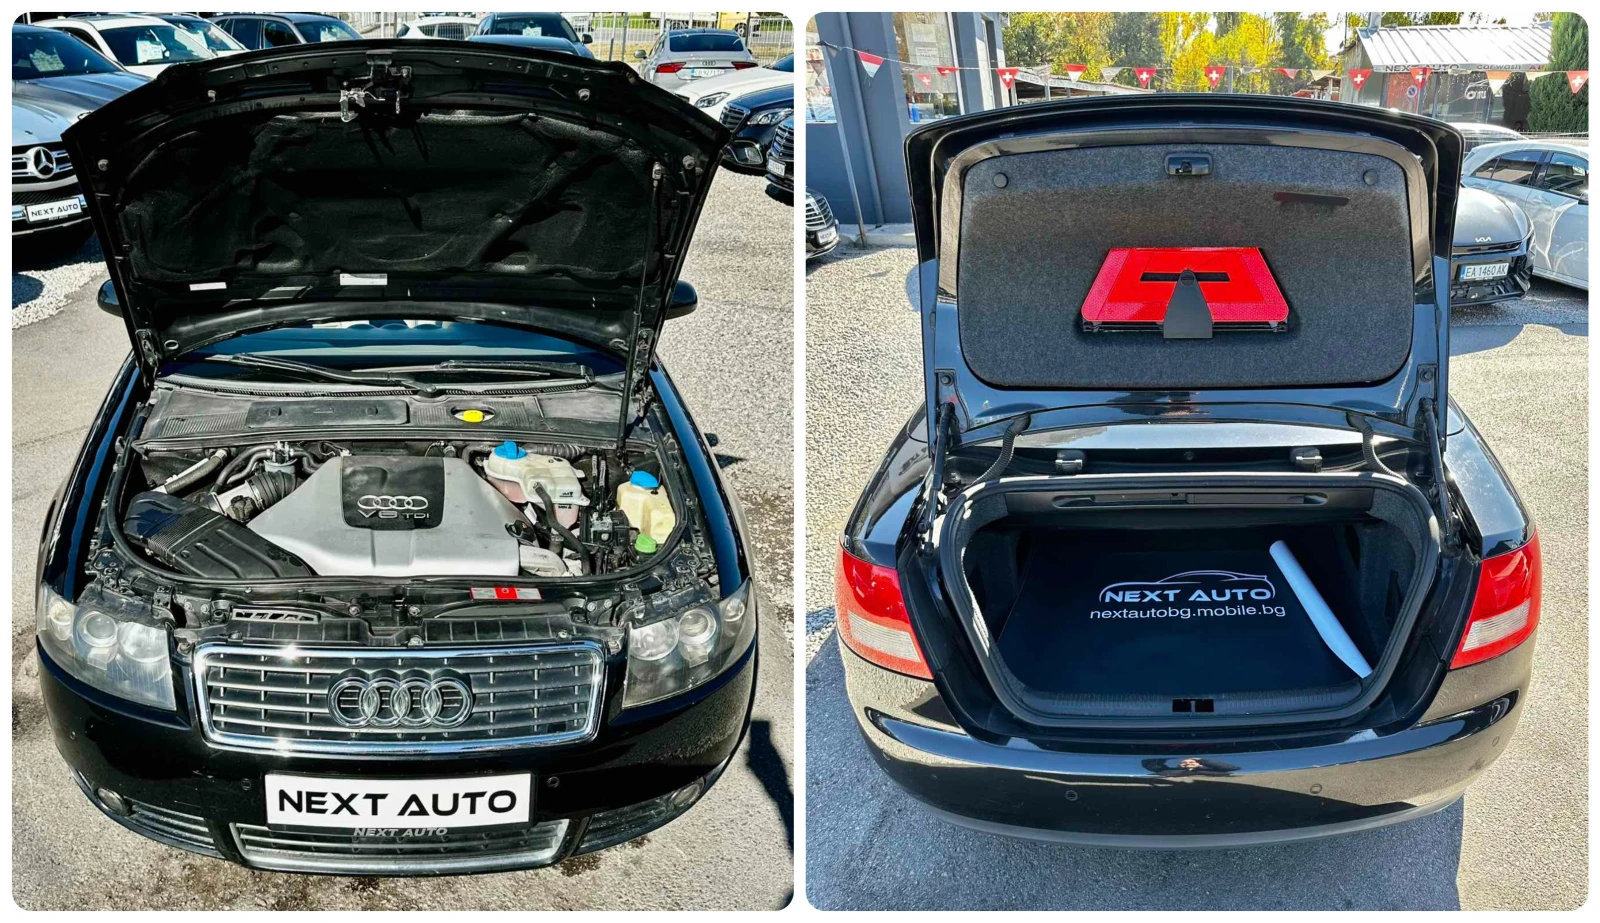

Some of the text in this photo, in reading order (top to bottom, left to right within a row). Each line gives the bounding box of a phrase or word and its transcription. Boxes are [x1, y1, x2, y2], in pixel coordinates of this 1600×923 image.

[31, 204, 79, 217] NEXT AUTO
[1466, 267, 1476, 277] EA
[1479, 265, 1497, 276] 1460
[357, 509, 398, 519] V6
[1104, 588, 1272, 603] NEXT AUTO
[1090, 604, 1286, 619] nextautobg.mobile.bg
[278, 789, 517, 816] NEXT AUTO
[353, 827, 448, 838] NEXT AUTO
